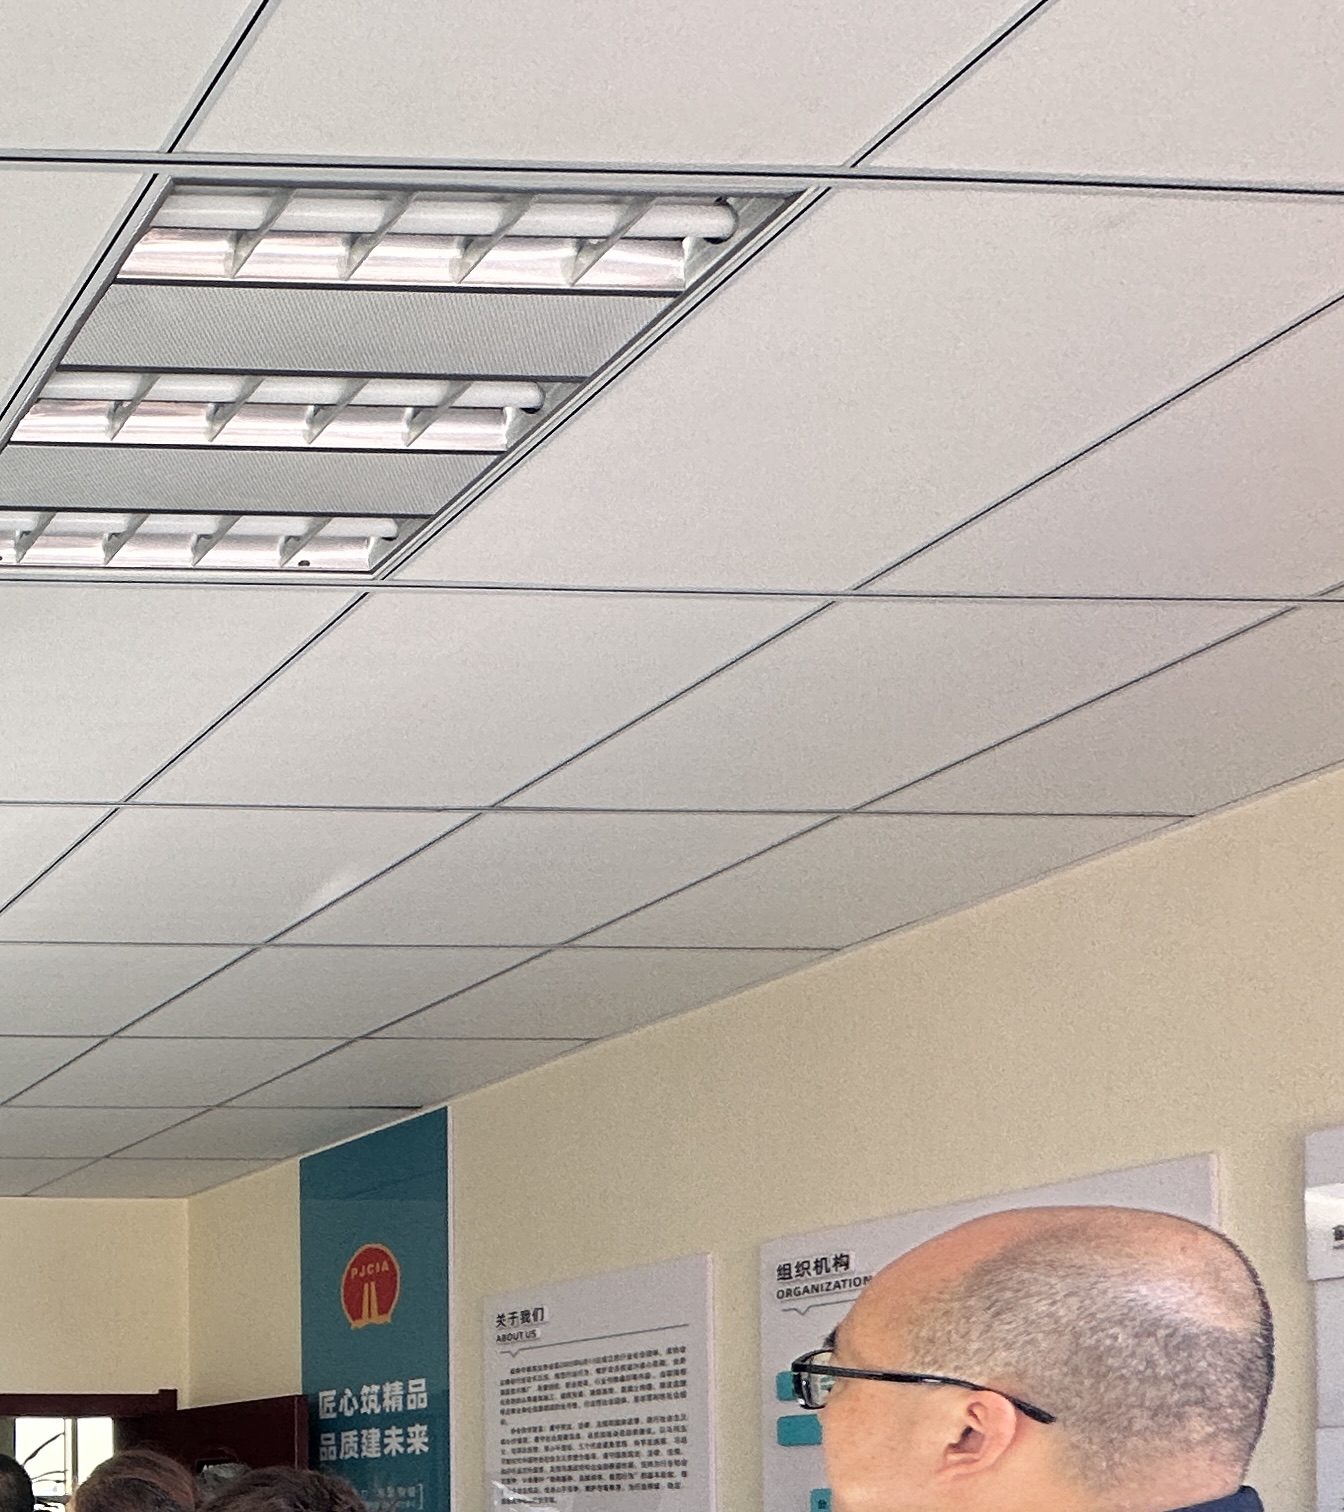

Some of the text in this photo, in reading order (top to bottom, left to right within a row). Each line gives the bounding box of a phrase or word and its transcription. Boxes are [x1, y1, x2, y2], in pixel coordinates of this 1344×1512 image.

[351, 1260, 389, 1279] PJCIA
[776, 1253, 851, 1281] 组织机构
[496, 1307, 544, 1328] 关于我们
[496, 1329, 537, 1343] ABOUT US
[318, 1378, 428, 1419] 匠心筑精品
[319, 1423, 430, 1461] 品质建未来
